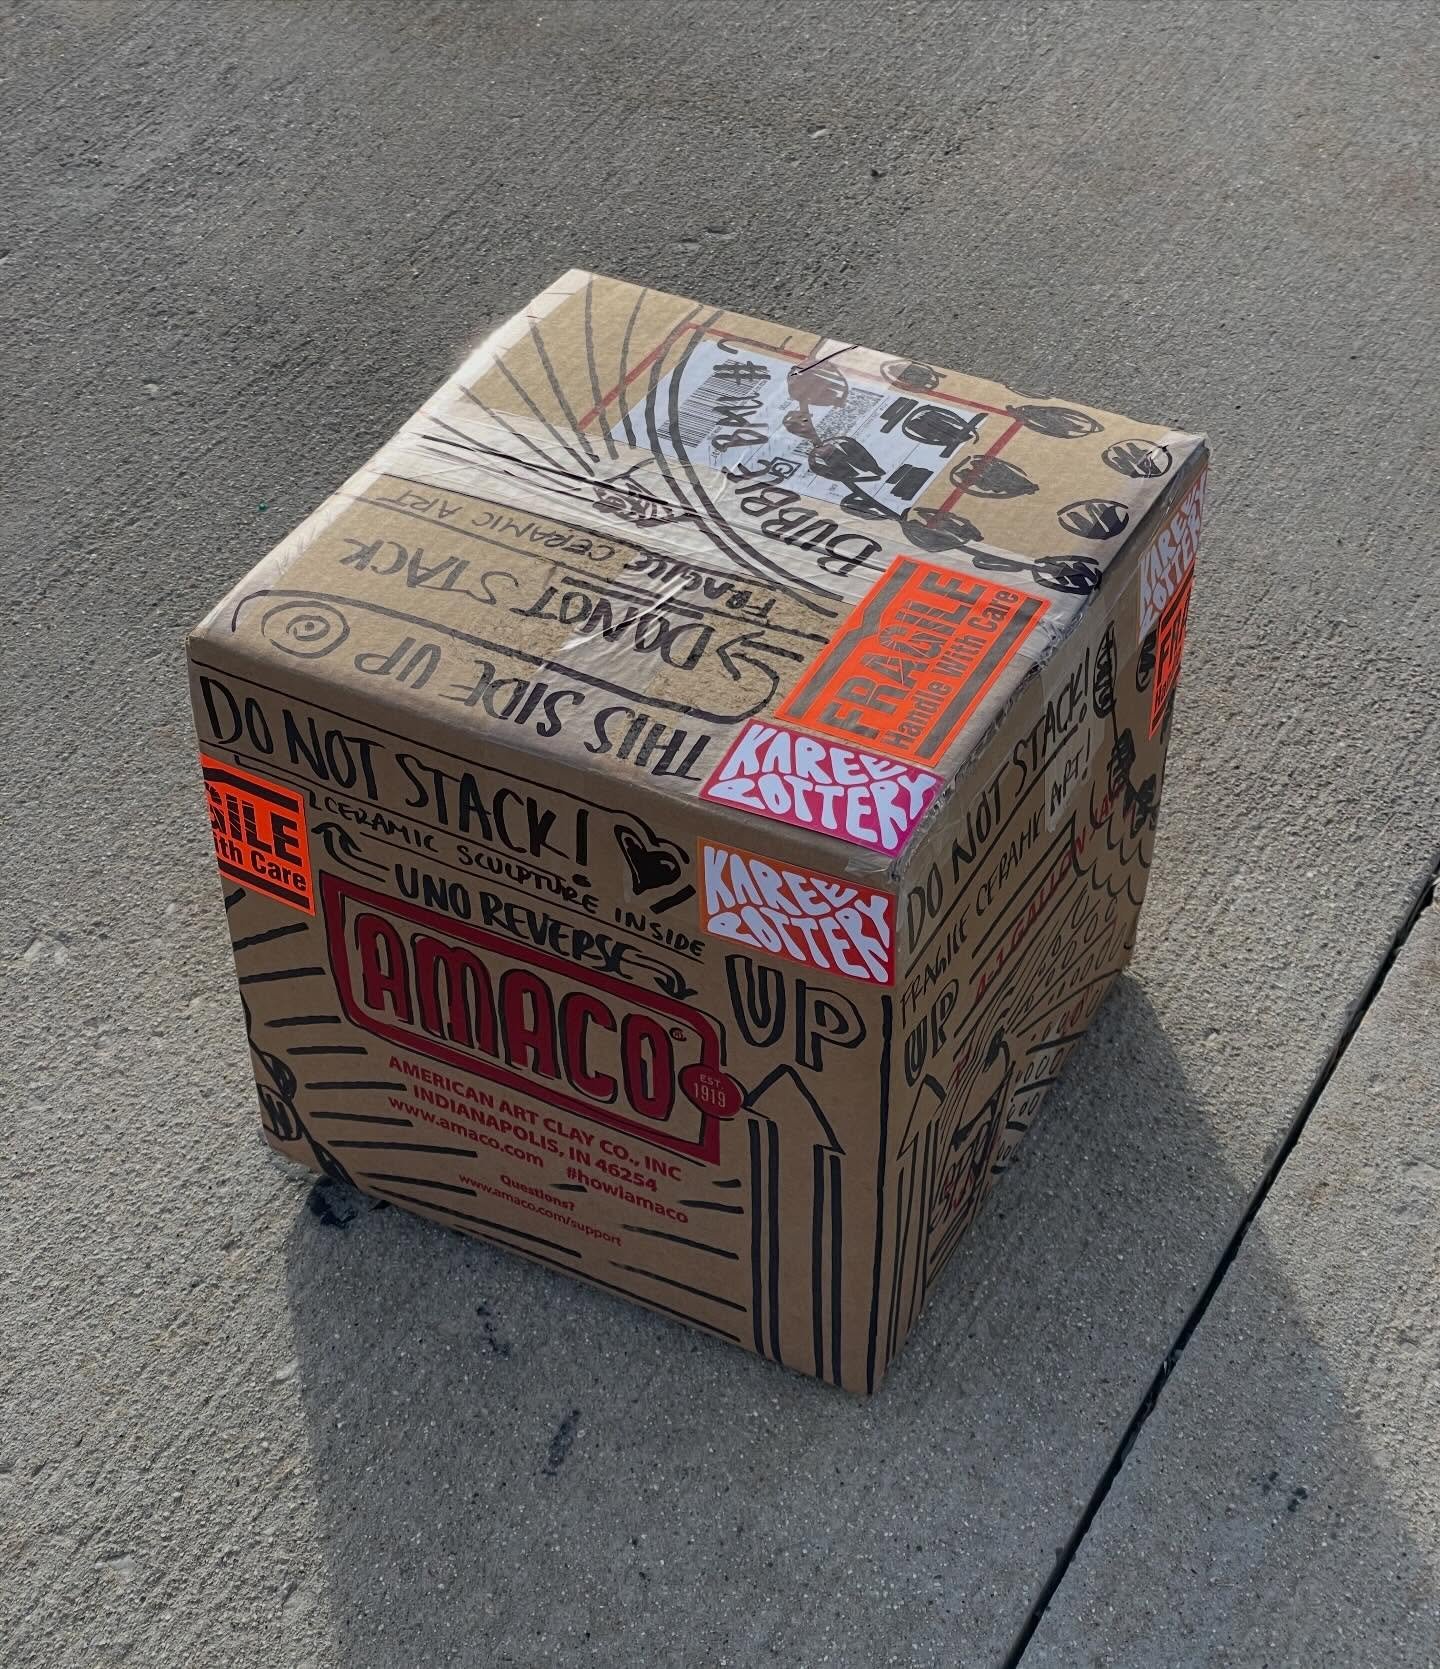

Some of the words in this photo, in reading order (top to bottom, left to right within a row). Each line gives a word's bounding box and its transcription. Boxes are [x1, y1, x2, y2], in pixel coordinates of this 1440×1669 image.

[374, 489, 464, 518] ART
[472, 511, 617, 565] CERAMIC
[340, 536, 520, 606] STACK
[355, 637, 442, 690] UP
[817, 571, 987, 740] FRAGILE
[881, 680, 951, 749] Handle
[932, 634, 988, 679] With
[968, 590, 1019, 633] Care
[440, 659, 585, 739] SIDE
[199, 675, 274, 754] DO
[282, 709, 386, 801] NOT
[395, 752, 592, 888] STACK!
[585, 706, 712, 781] THIS
[707, 773, 936, 850] POTTERY
[906, 862, 944, 953] DO
[952, 761, 1010, 883] NOT
[1012, 647, 1090, 797] STACK!
[250, 850, 307, 891] Care
[324, 797, 438, 852] CERAMIC
[457, 845, 600, 914] SCULPTURE
[615, 907, 705, 958] INSIDE
[395, 864, 471, 920] UNO
[479, 890, 640, 979] REVERSE
[706, 895, 890, 983] POTTERY
[725, 954, 867, 1072] UP
[904, 978, 959, 1087] UP
[388, 1096, 544, 1168] www.amaco.com
[389, 1055, 494, 1108] AMERICAN
[499, 1100, 539, 1125] ART
[543, 1118, 595, 1147] CLAY
[645, 1156, 682, 1182] INC
[693, 1083, 726, 1108] 1919
[413, 1085, 564, 1157] INDIANAPOLIS,
[569, 1147, 591, 1167] IN
[595, 1159, 658, 1192] 46254
[459, 1174, 623, 1247] www.amaco.com/support
[500, 1174, 575, 1211] Questions?
